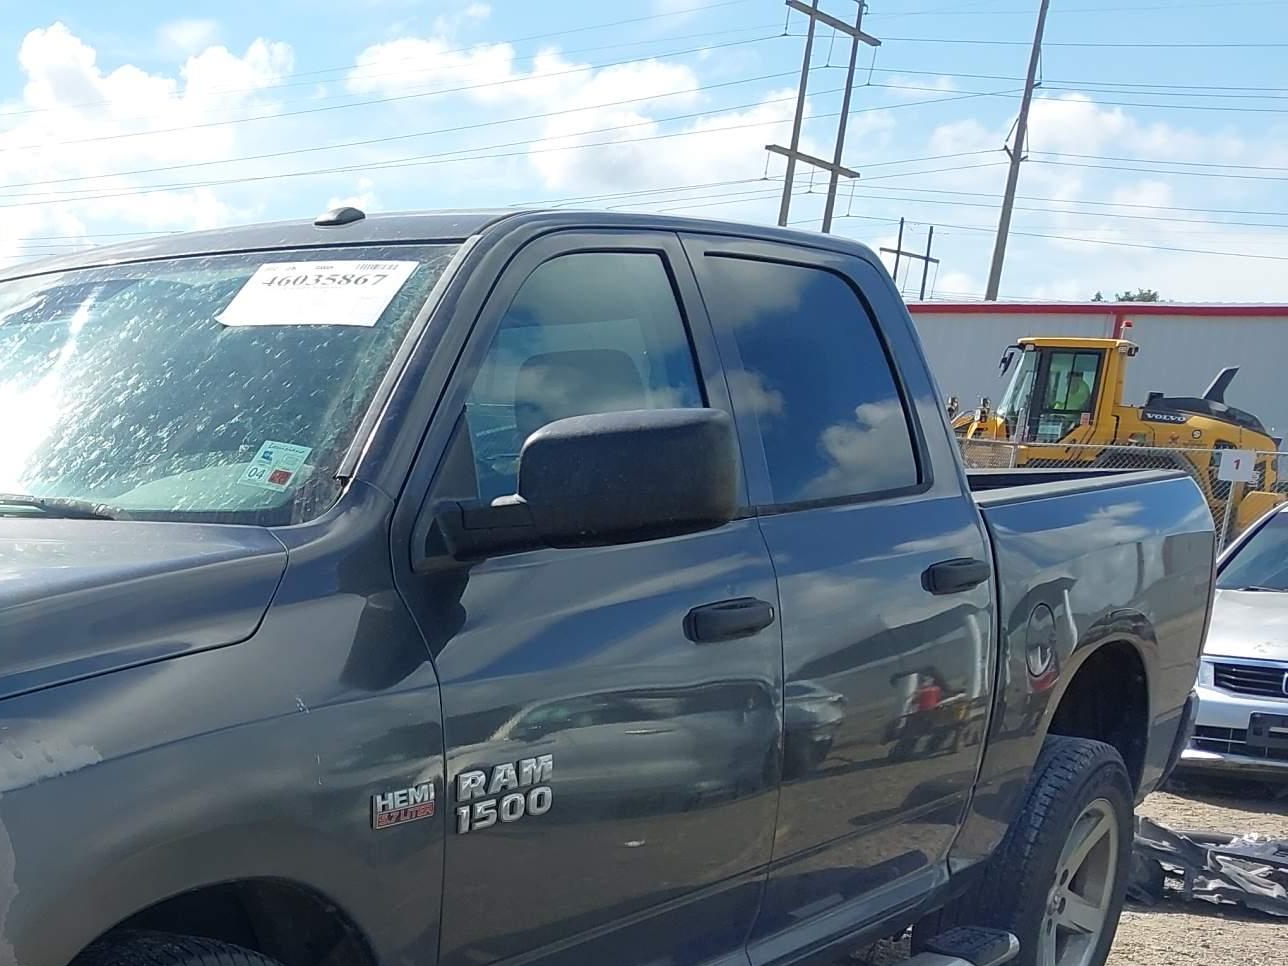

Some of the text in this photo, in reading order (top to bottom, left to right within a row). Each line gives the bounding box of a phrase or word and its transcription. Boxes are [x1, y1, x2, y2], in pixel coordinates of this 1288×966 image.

[261, 273, 390, 287] 46035867
[1146, 412, 1187, 422] VOLVO
[1233, 458, 1241, 471] 1
[247, 467, 266, 479] 04
[456, 753, 554, 802] RAM
[374, 783, 435, 813] HEMI
[399, 802, 434, 820] LITER
[456, 786, 554, 834] 1500
